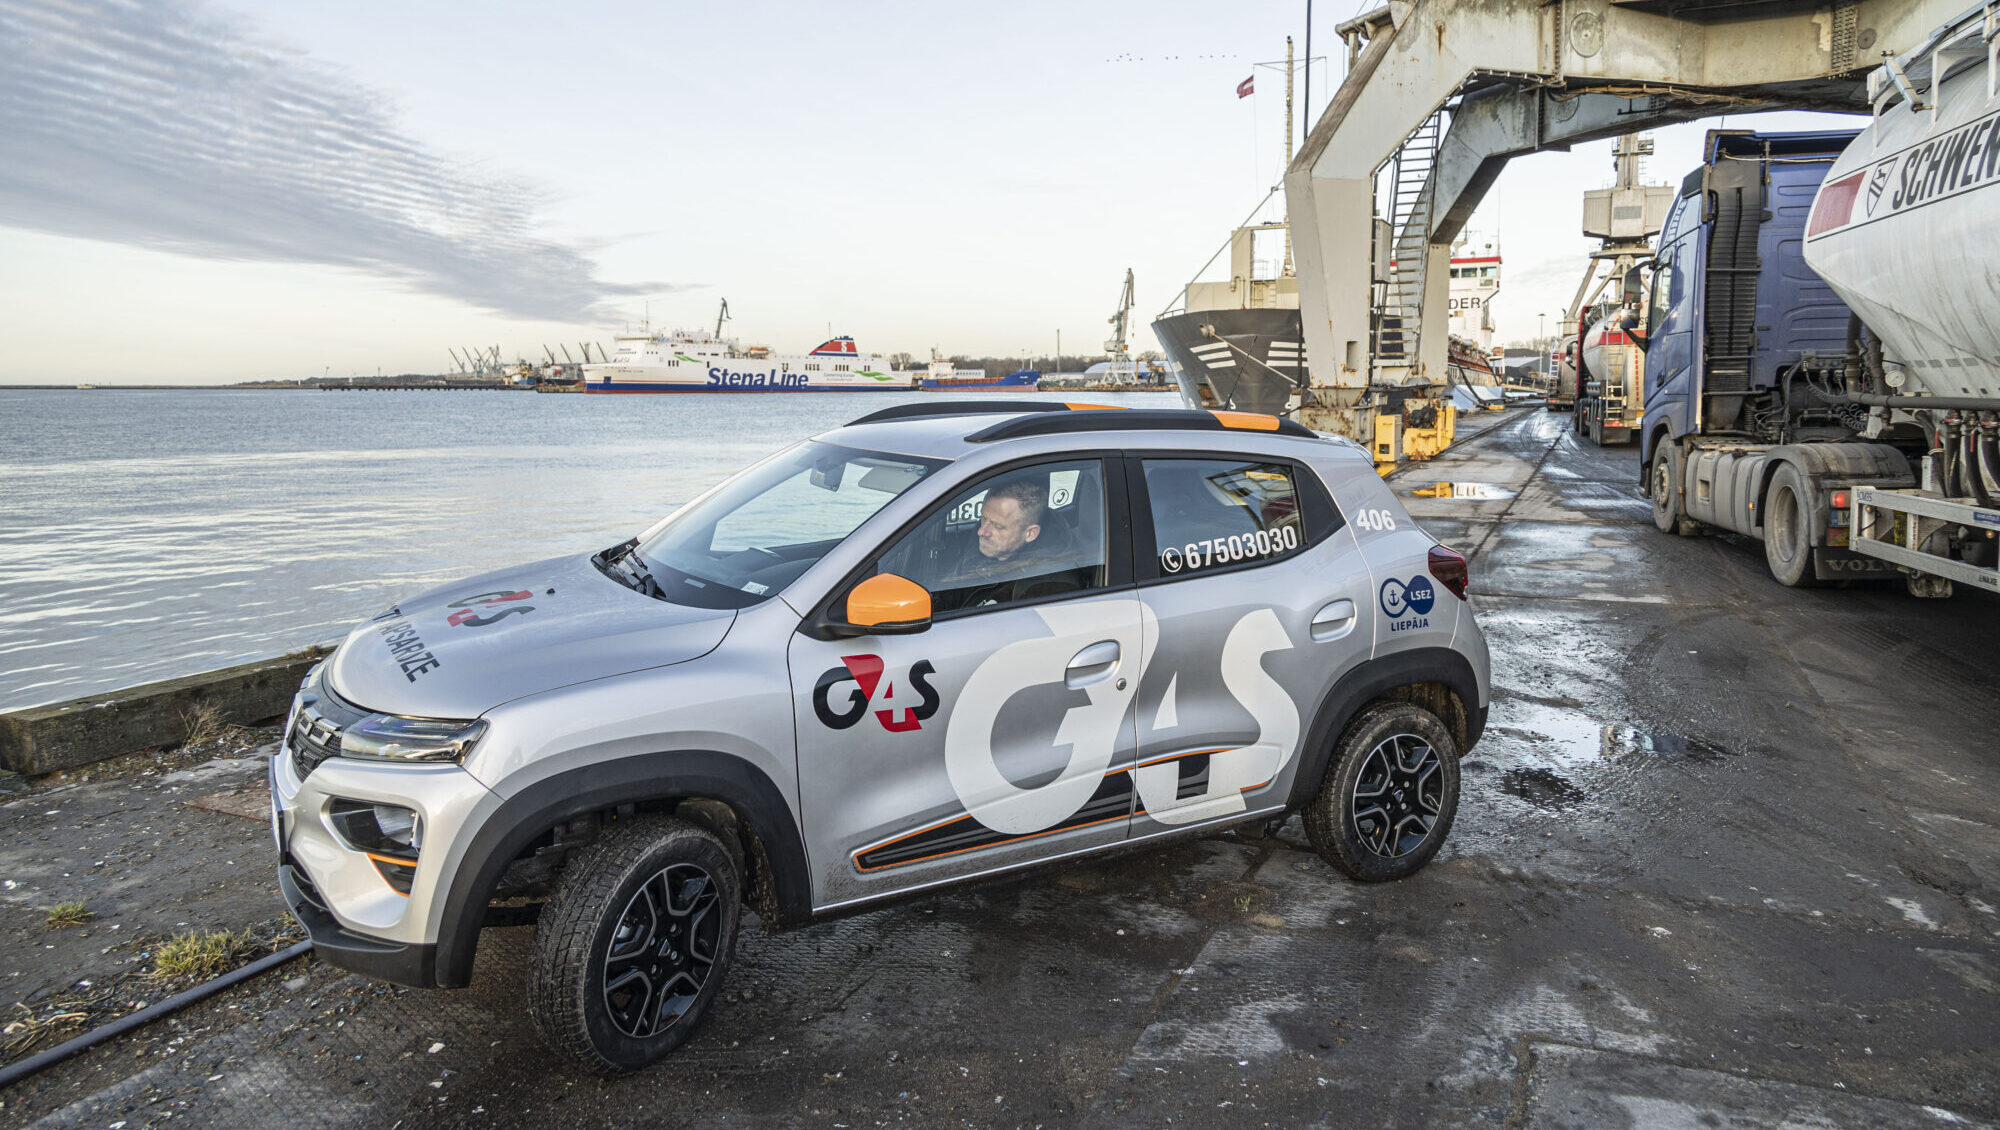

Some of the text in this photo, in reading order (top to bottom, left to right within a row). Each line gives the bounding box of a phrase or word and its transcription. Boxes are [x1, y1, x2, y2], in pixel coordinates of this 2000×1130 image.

[1892, 115, 2000, 210] SCHWEN
[1449, 297, 1481, 309] DER
[707, 368, 767, 387] Stena
[769, 368, 809, 387] Line
[1356, 508, 1396, 531] 406
[1184, 525, 1298, 569] 67503030
[1825, 560, 1897, 572] VOLV
[1410, 589, 1432, 601] LSEZ
[447, 589, 536, 627] G4S
[1391, 617, 1429, 632] LIEPĀJA
[813, 654, 940, 733] G4S
[945, 599, 1300, 835] G4S
